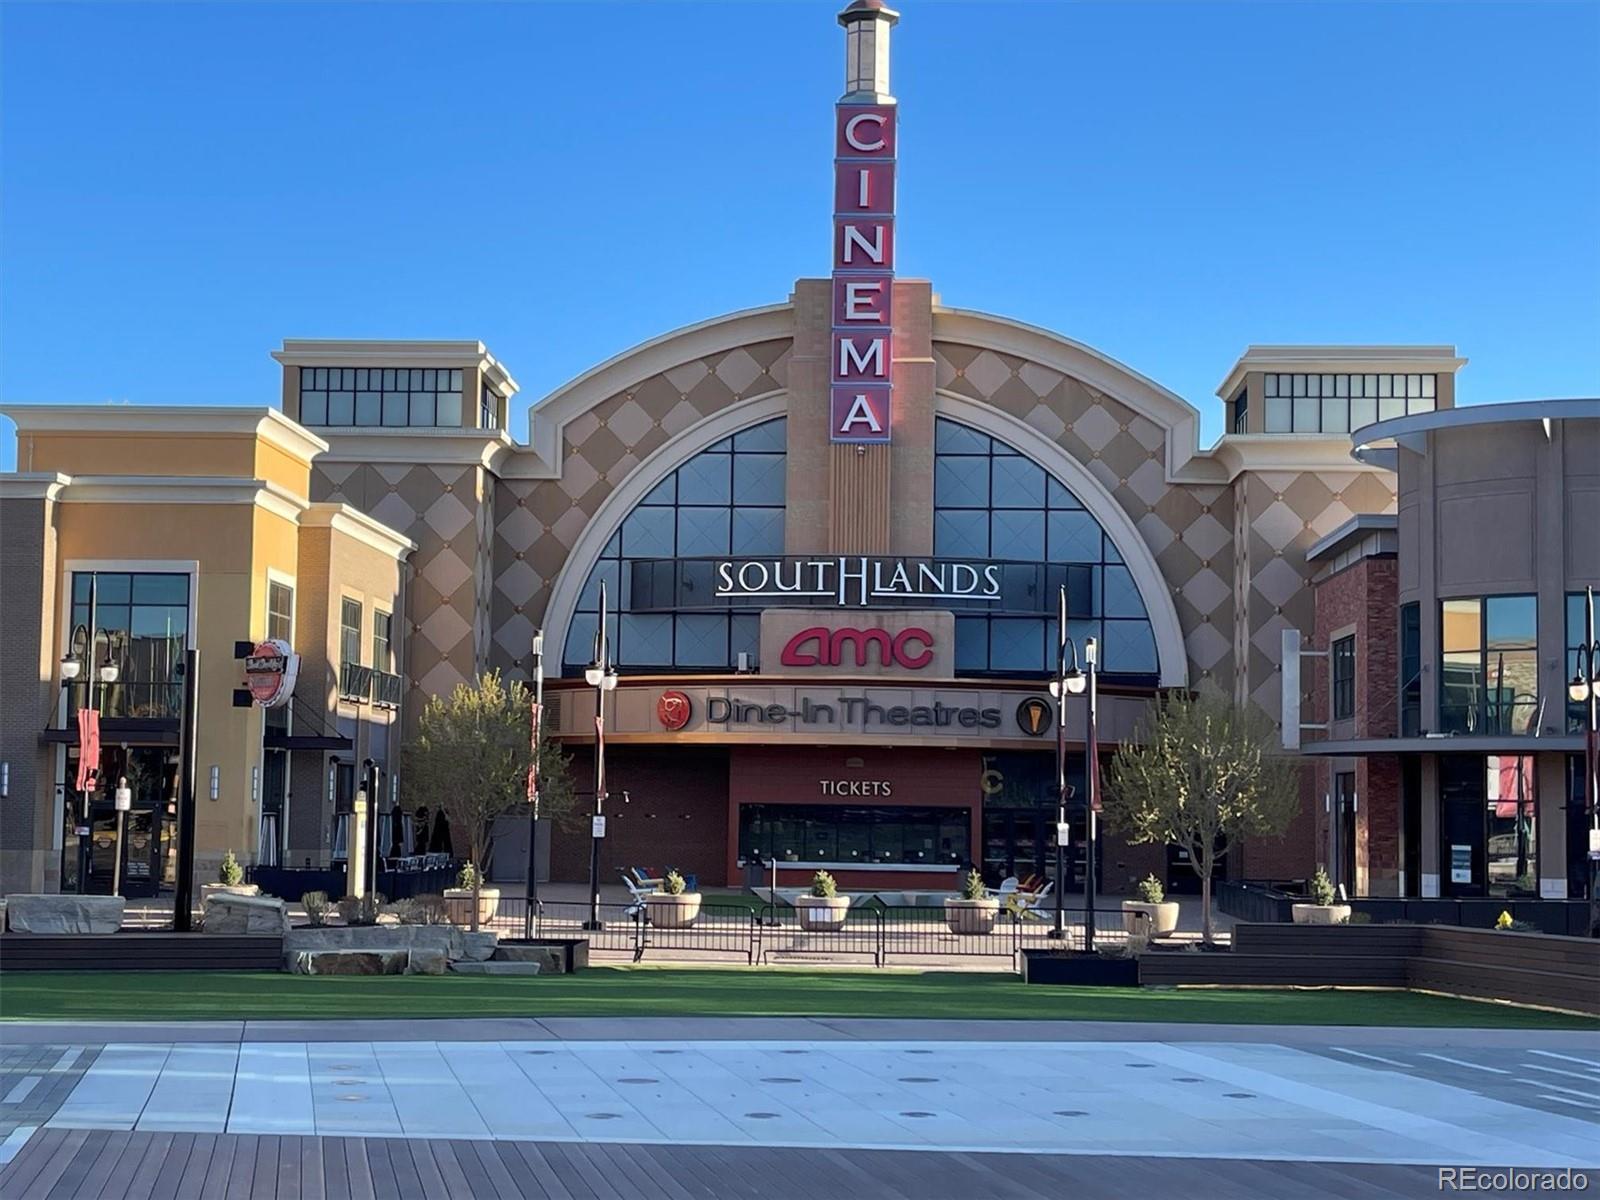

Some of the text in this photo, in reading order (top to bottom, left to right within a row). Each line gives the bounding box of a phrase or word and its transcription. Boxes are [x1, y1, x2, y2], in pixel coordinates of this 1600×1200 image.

[840, 112, 887, 433] CINEMA
[717, 557, 1001, 605] SOUTHLANDS
[705, 696, 1002, 728] Dine-In Theatres
[819, 780, 892, 797] TICKETS
